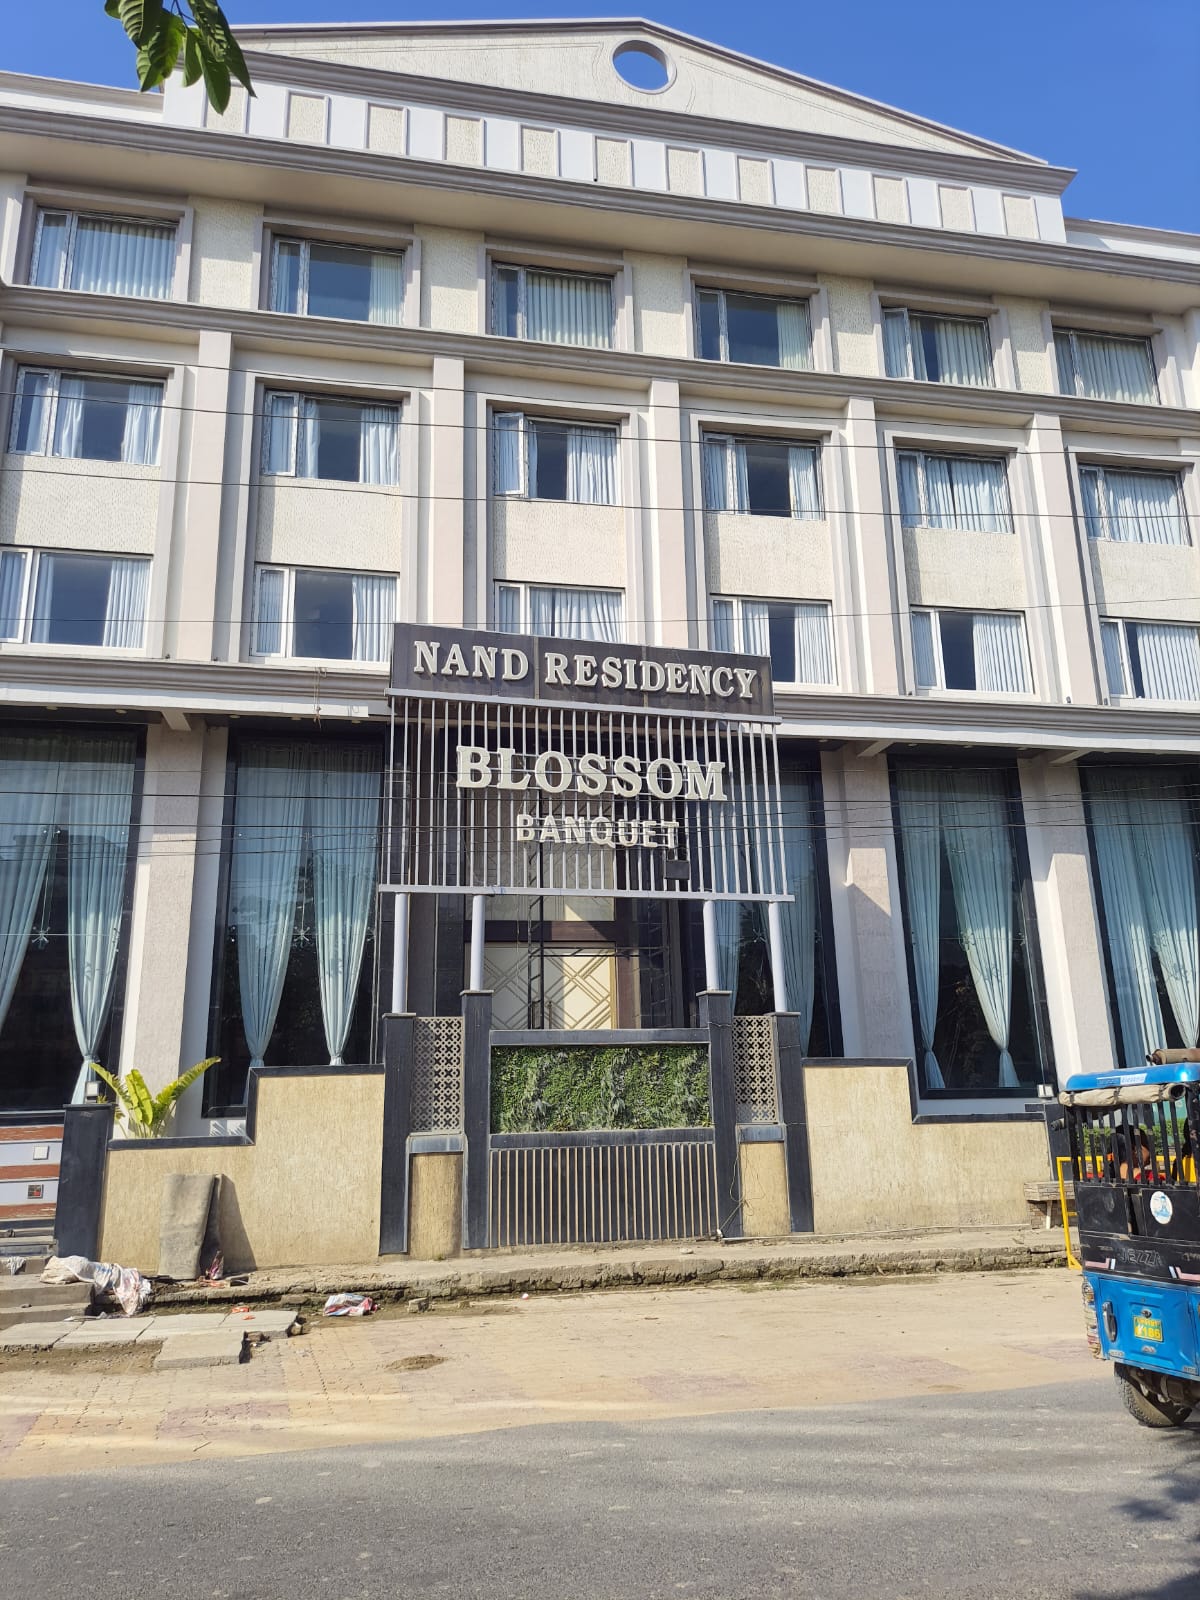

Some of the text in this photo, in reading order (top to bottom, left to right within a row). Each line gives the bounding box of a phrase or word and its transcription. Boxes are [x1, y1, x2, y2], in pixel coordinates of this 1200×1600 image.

[413, 640, 757, 698] NAND RESIDENCY
[456, 745, 728, 801] BLOSSOM
[516, 813, 680, 849] BANQUET
